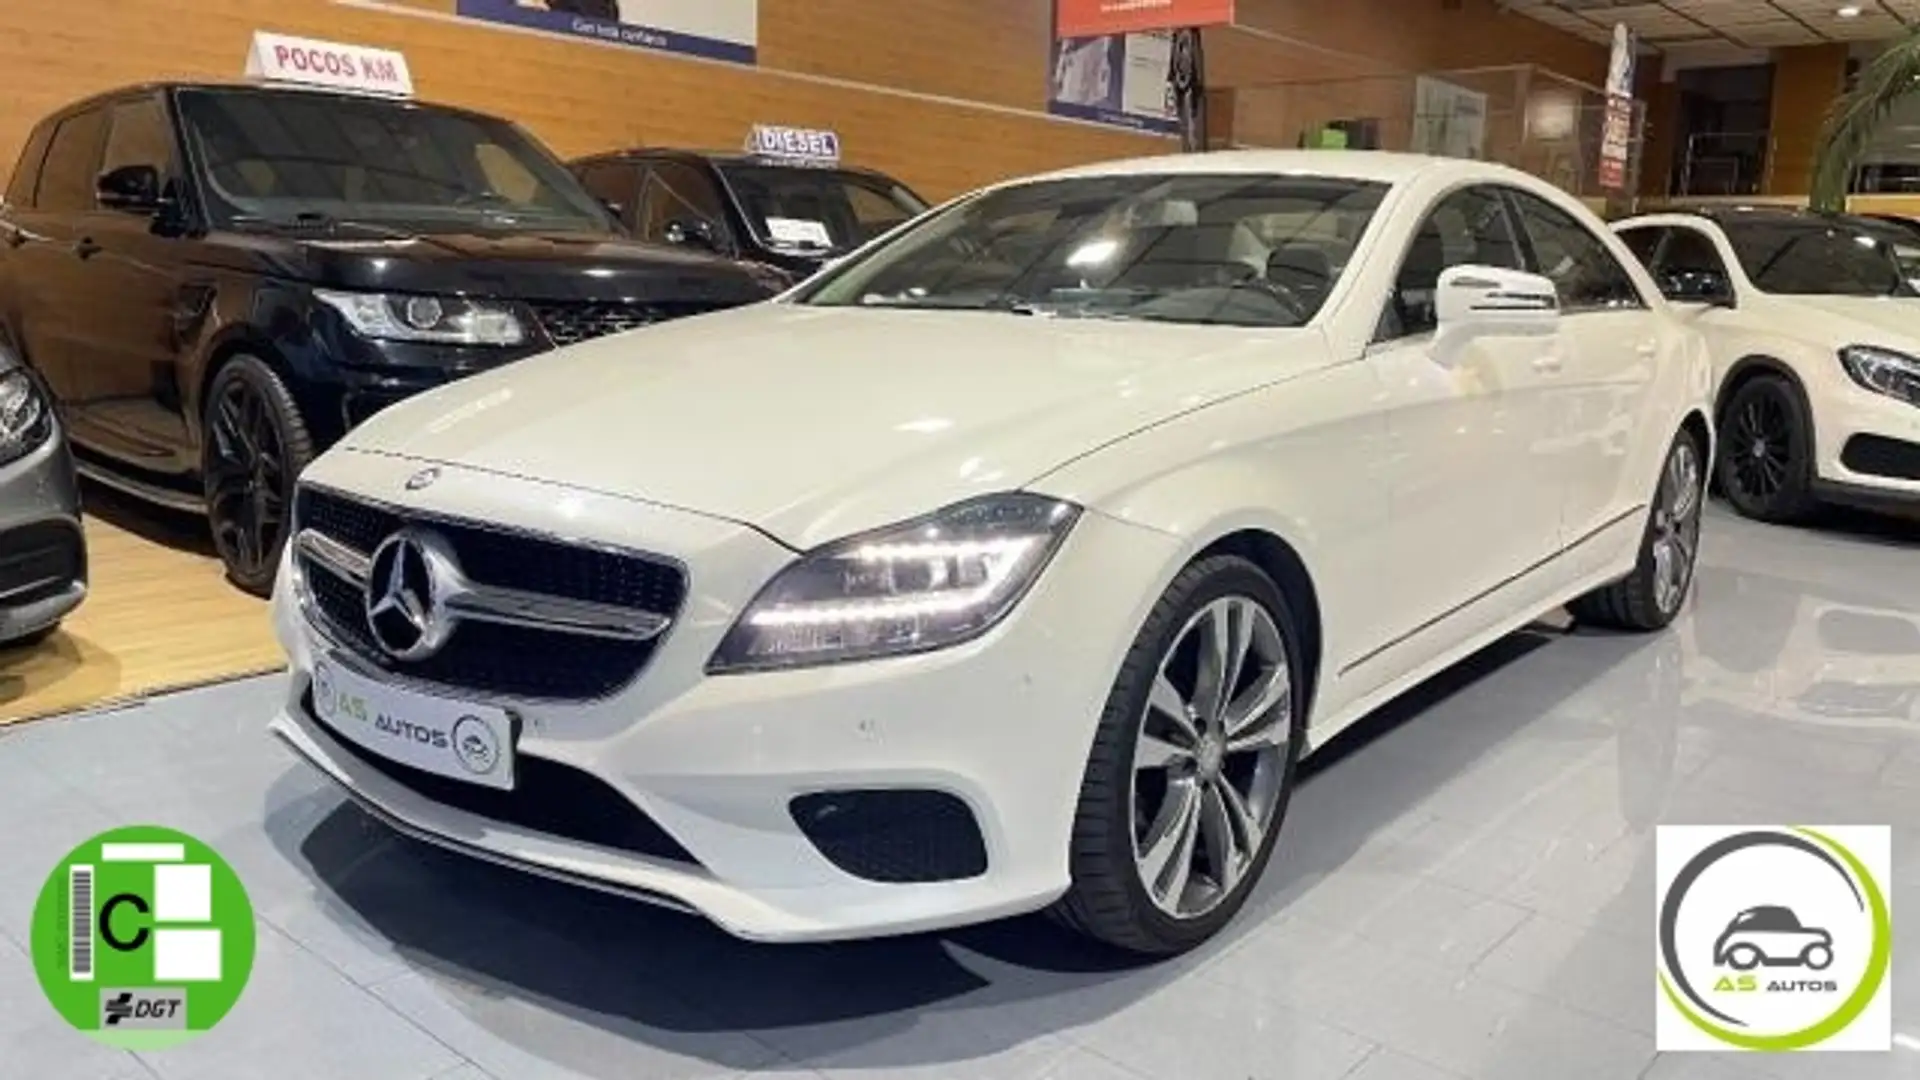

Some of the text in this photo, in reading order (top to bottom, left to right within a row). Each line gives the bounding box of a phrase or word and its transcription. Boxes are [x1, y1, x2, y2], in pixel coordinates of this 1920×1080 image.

[273, 44, 398, 82] POCOS KM
[763, 129, 833, 155] DIESEL
[339, 692, 449, 749] AS AUTOS
